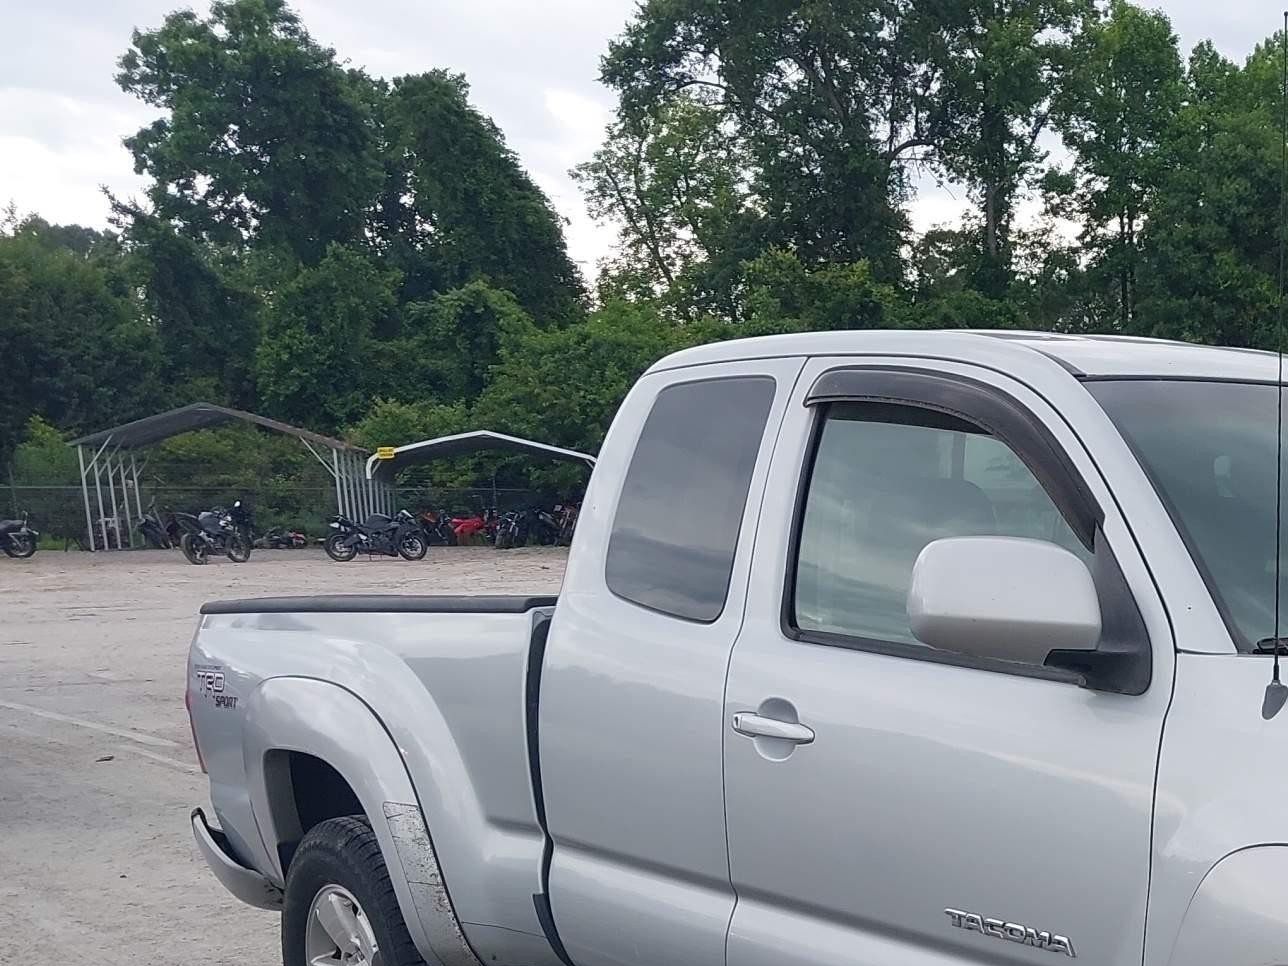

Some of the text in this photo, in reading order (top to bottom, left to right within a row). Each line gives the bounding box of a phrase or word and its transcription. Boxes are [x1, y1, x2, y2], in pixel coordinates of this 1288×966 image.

[197, 670, 225, 698] TRD
[215, 695, 238, 709] SPORT
[944, 907, 1077, 958] TACOMA
